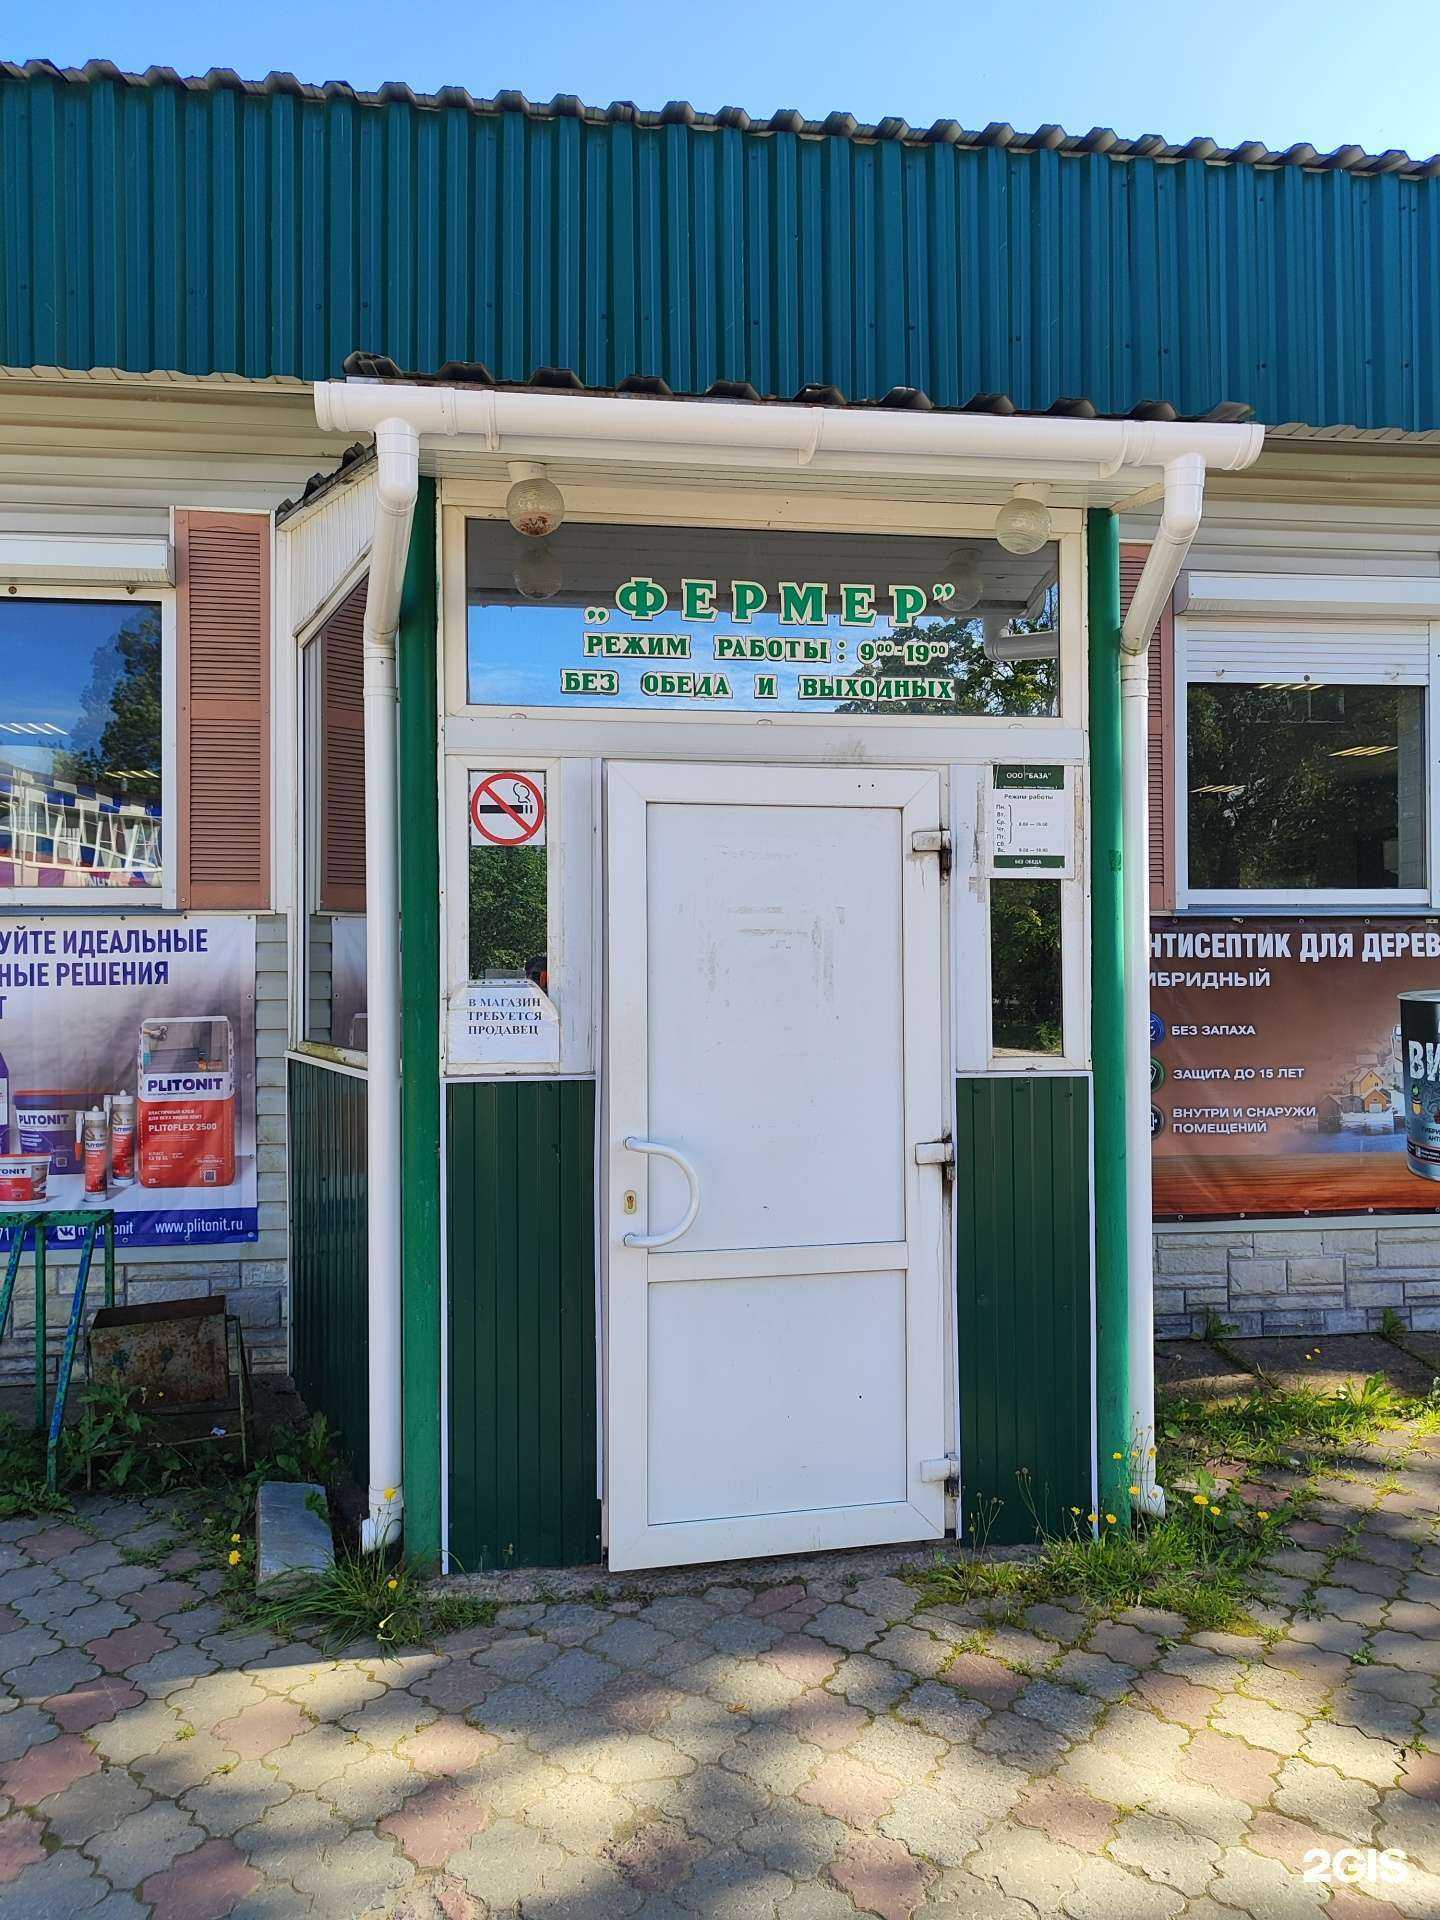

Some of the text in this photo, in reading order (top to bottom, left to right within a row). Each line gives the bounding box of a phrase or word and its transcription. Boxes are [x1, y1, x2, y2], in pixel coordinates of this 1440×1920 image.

[585, 633, 690, 657] РЕЖИМ
[561, 670, 955, 700] БЕЗ ОБЕДА И ВЫХОДНЫХ
[63, 929, 208, 958] ИДЕАЛЬНЫЕ
[1300, 933, 1353, 963] ДЛЯ
[1361, 933, 1440, 963] ДЕРЕВ
[56, 961, 168, 986] РЕШЕНИЯ
[468, 998, 541, 1008] В МАГАЗИН
[467, 1011, 542, 1021] ТРЕБУЕТСЯ
[468, 1025, 539, 1036] ПРОДАВЕЦ
[1171, 1025, 1257, 1036] БЕЗ ЗАПАХА
[1173, 1068, 1305, 1081] ЗАЩИТА ДО 15 ЛЕТ
[148, 1078, 224, 1092] PLITONIT
[1172, 1106, 1317, 1119] ВНУТРИ И СНАРУЖИ
[19, 1114, 70, 1125] PLITONIT
[149, 1124, 195, 1133] PLITOFLEX
[1172, 1120, 1268, 1135] ПОМЕЩЕНИЙ
[155, 1218, 243, 1237] www.plitonit.ru
